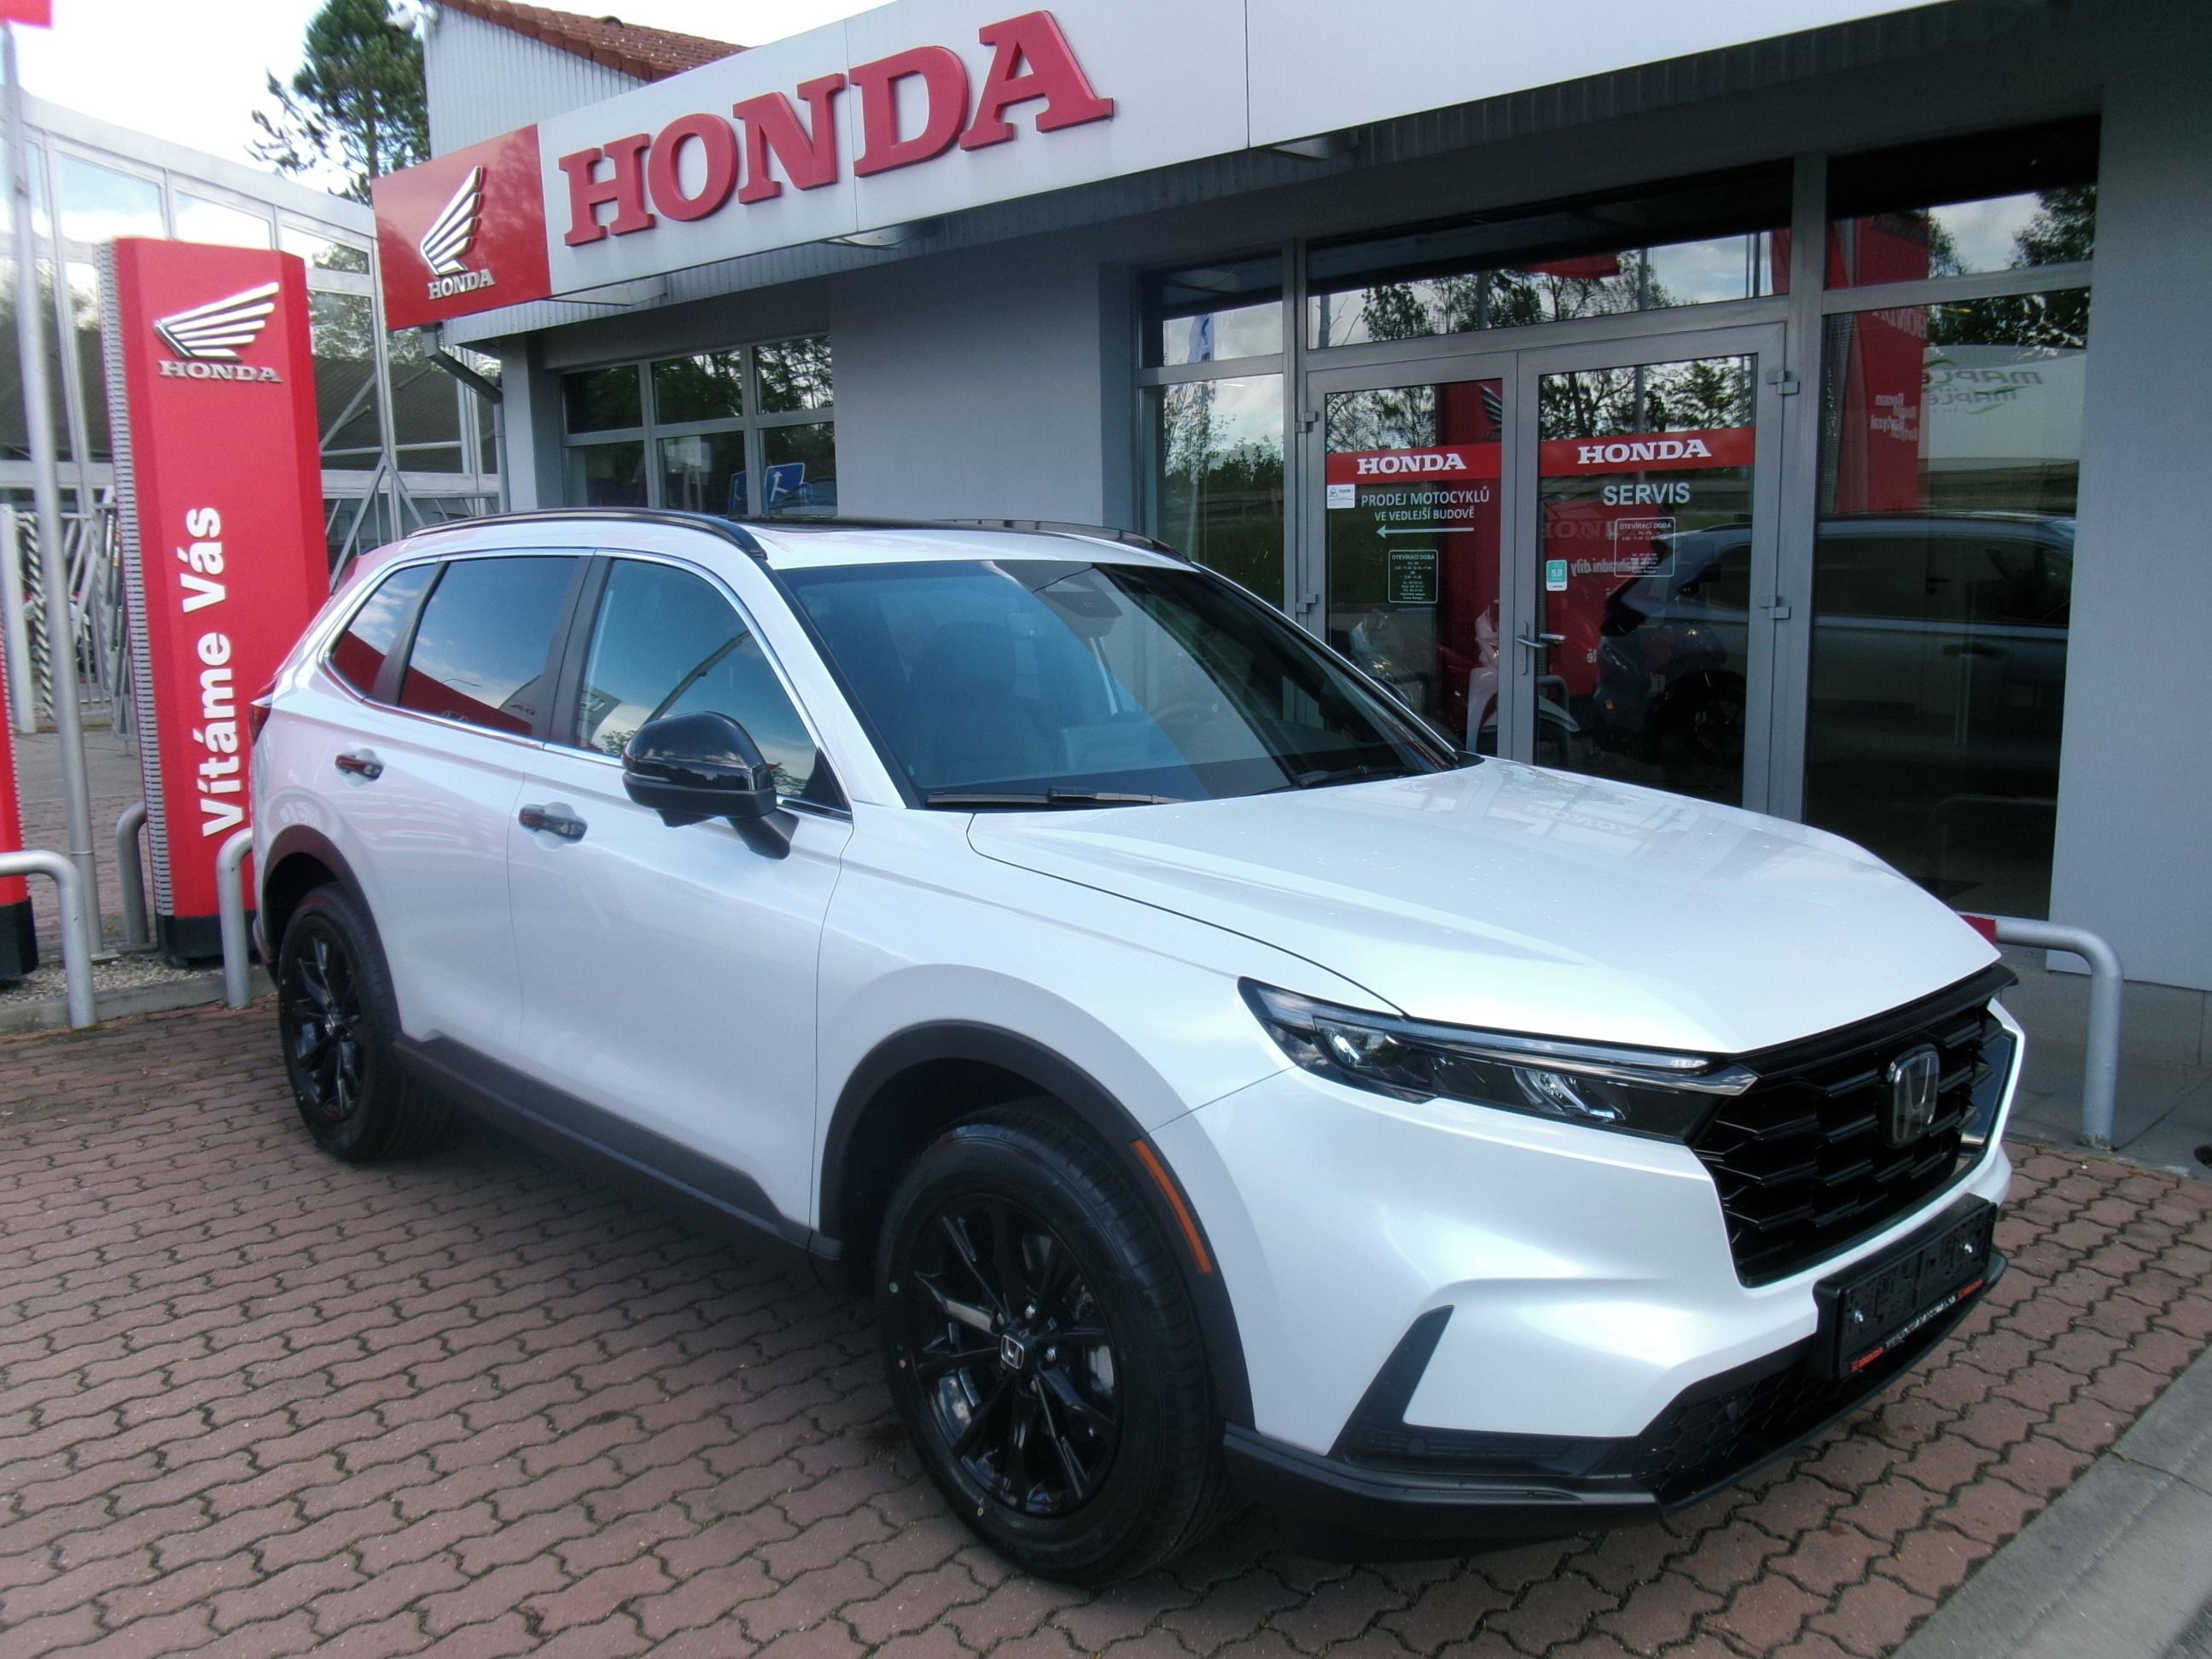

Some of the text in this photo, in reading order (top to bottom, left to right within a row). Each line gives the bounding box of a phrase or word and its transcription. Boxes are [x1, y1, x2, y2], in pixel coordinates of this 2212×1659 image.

[558, 10, 1114, 247] HONDA
[428, 269, 496, 300] HONDA
[158, 360, 282, 383] HONDA
[1357, 453, 1467, 474] HONDA
[1577, 439, 1712, 465] HONDA
[1361, 492, 1406, 507] PRODEJ
[1410, 486, 1489, 505] MOTOCYKLŮ
[1603, 482, 1691, 506] SERVIS
[1375, 506, 1475, 521] VE VEDLEJŠÍ BUDOVĚ
[1619, 521, 1652, 530] OTEVÍRACÍ
[177, 507, 244, 837] Vítáme Vás
